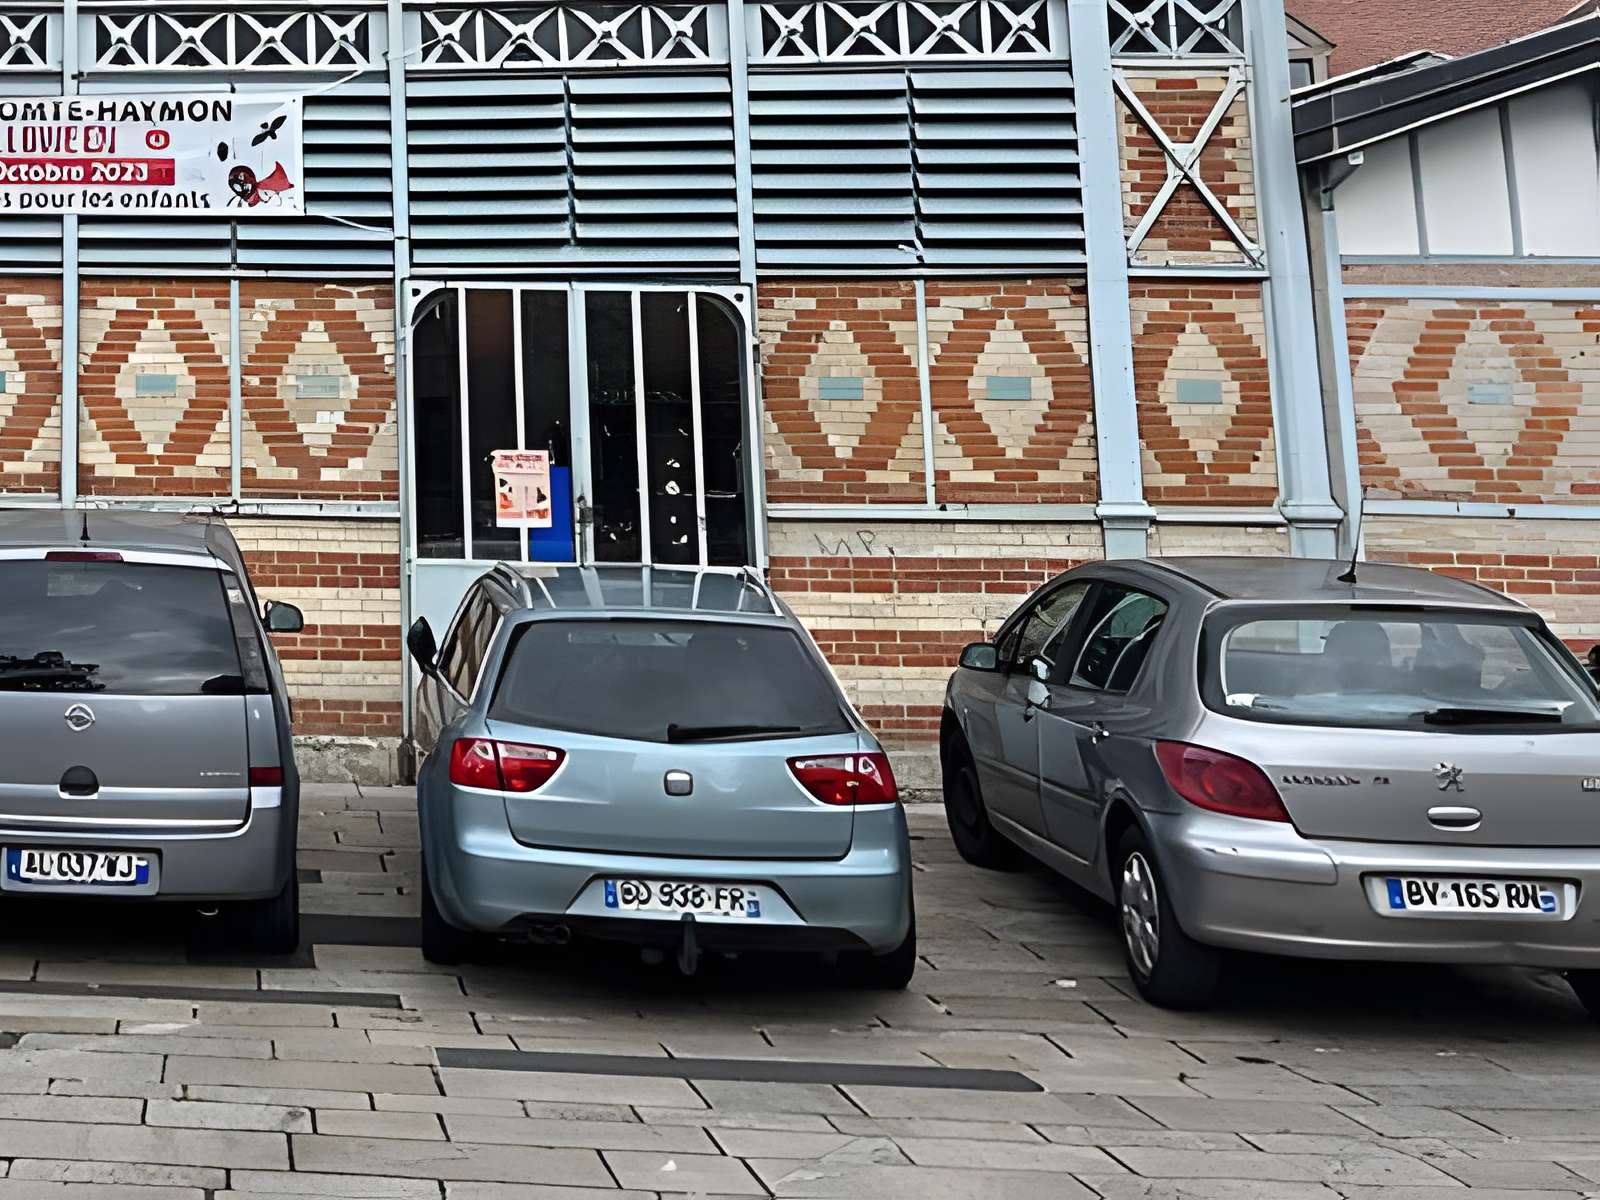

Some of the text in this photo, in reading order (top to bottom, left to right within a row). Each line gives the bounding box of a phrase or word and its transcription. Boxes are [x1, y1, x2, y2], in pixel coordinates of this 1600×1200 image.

[19, 191, 76, 209] pour
[82, 189, 114, 208] les
[120, 189, 211, 209] enfants
